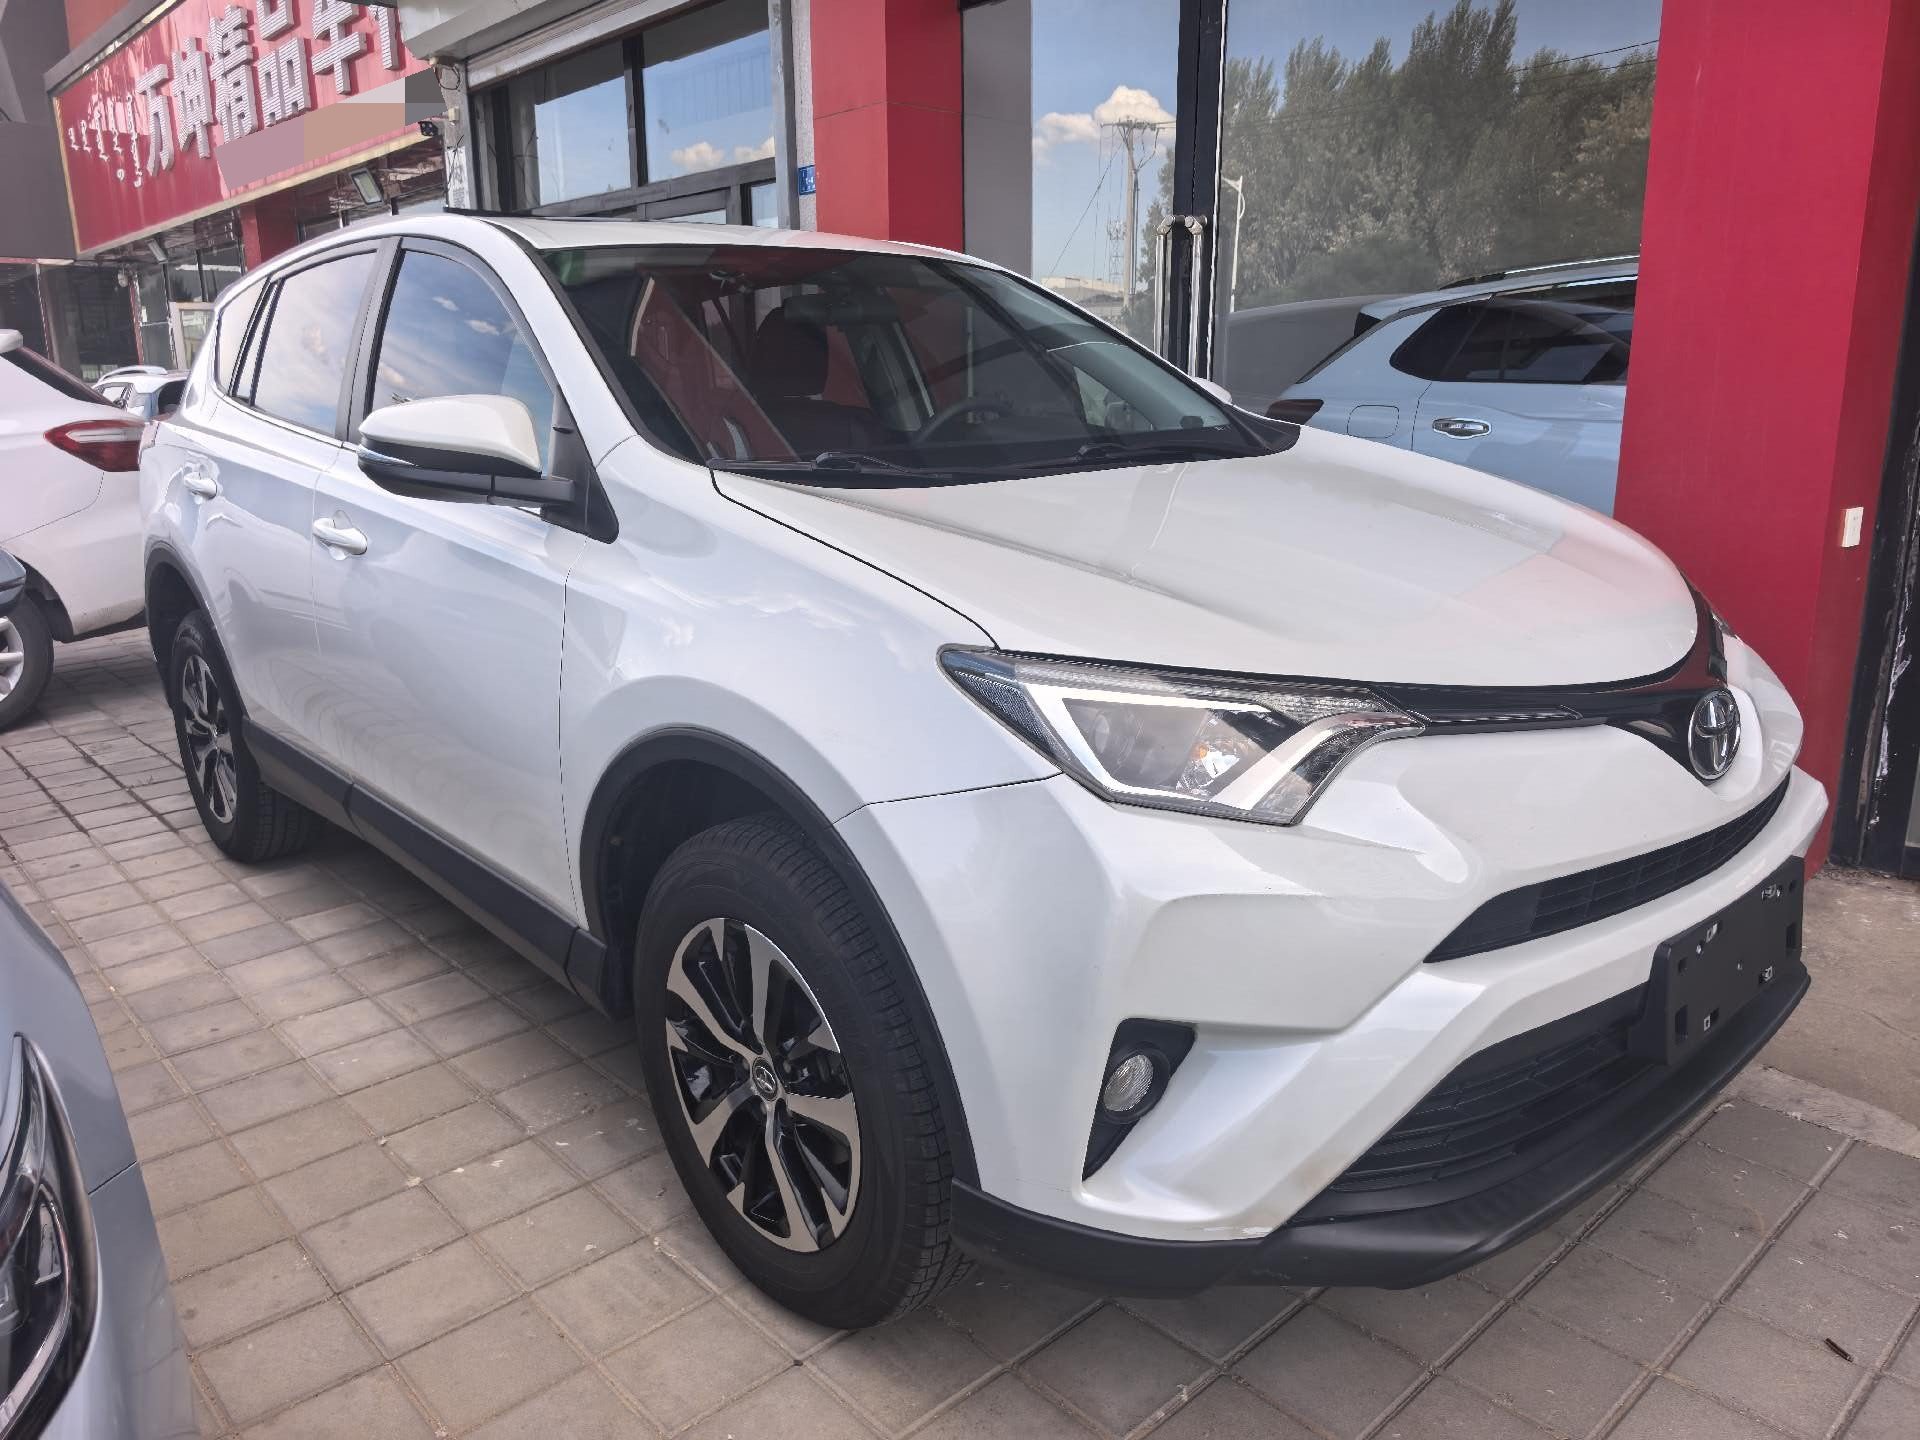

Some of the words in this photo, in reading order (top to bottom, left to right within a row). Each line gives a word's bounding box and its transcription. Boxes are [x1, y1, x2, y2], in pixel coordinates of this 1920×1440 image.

[135, 0, 400, 177] 万坤精品车
